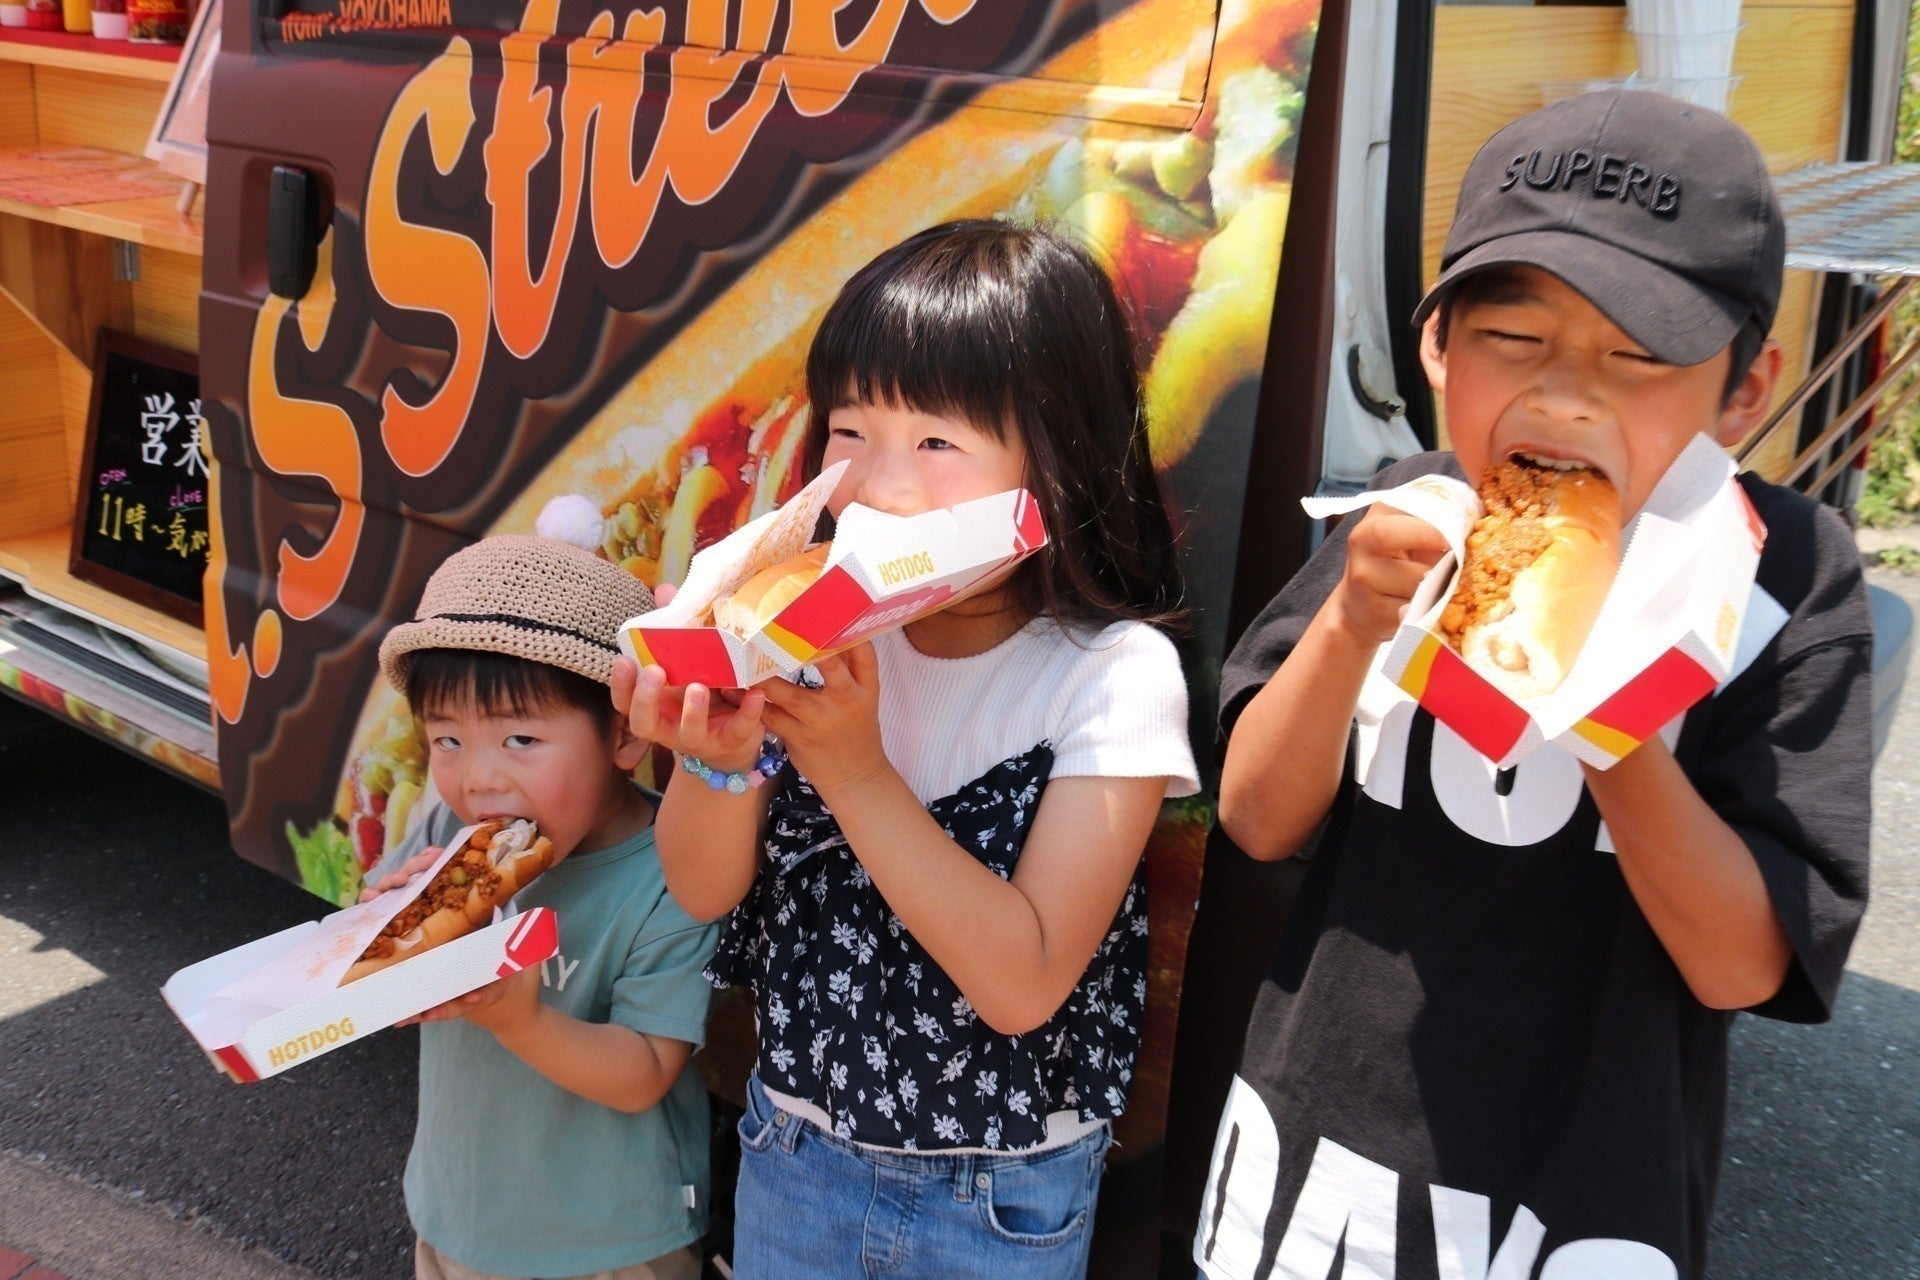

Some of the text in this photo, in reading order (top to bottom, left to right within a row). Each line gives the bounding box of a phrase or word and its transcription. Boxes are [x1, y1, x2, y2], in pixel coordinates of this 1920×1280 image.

[1499, 148, 1682, 218] SUPERB
[366, 0, 977, 477] Stree
[877, 551, 934, 587] HOTDOG
[268, 1016, 356, 1068] HOTDOG
